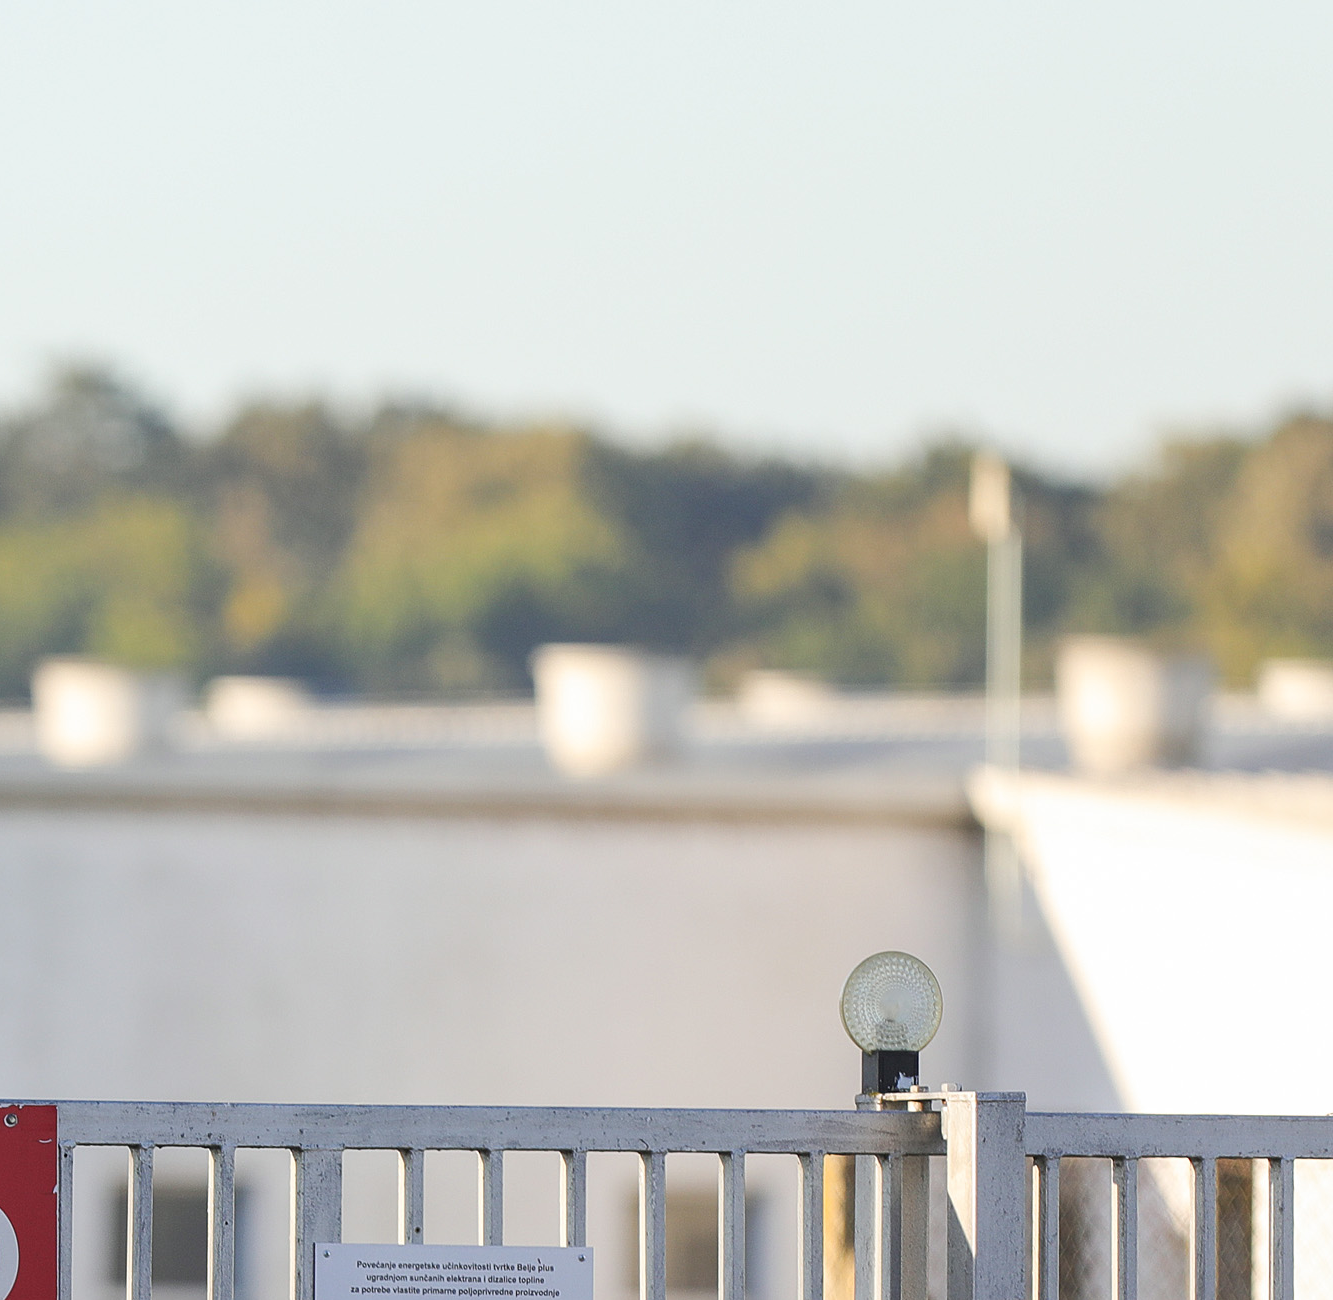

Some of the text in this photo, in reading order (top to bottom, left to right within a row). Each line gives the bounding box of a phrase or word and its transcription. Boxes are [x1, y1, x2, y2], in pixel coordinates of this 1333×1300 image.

[357, 1260, 396, 1270] Povećanje
[397, 1262, 440, 1270] energetske
[442, 1262, 491, 1270] učinkovitosti
[517, 1263, 535, 1272] Belje
[537, 1262, 554, 1272] plus
[366, 1273, 407, 1282] ugradnjom
[446, 1274, 481, 1282] elektrana
[487, 1275, 516, 1283] dizalice
[518, 1276, 544, 1285] topline
[361, 1285, 390, 1294] potrebe
[392, 1286, 420, 1294] vlastite
[422, 1287, 456, 1295] primarne
[458, 1287, 513, 1296] poljoprivredne
[515, 1288, 559, 1298] proizvodnje
